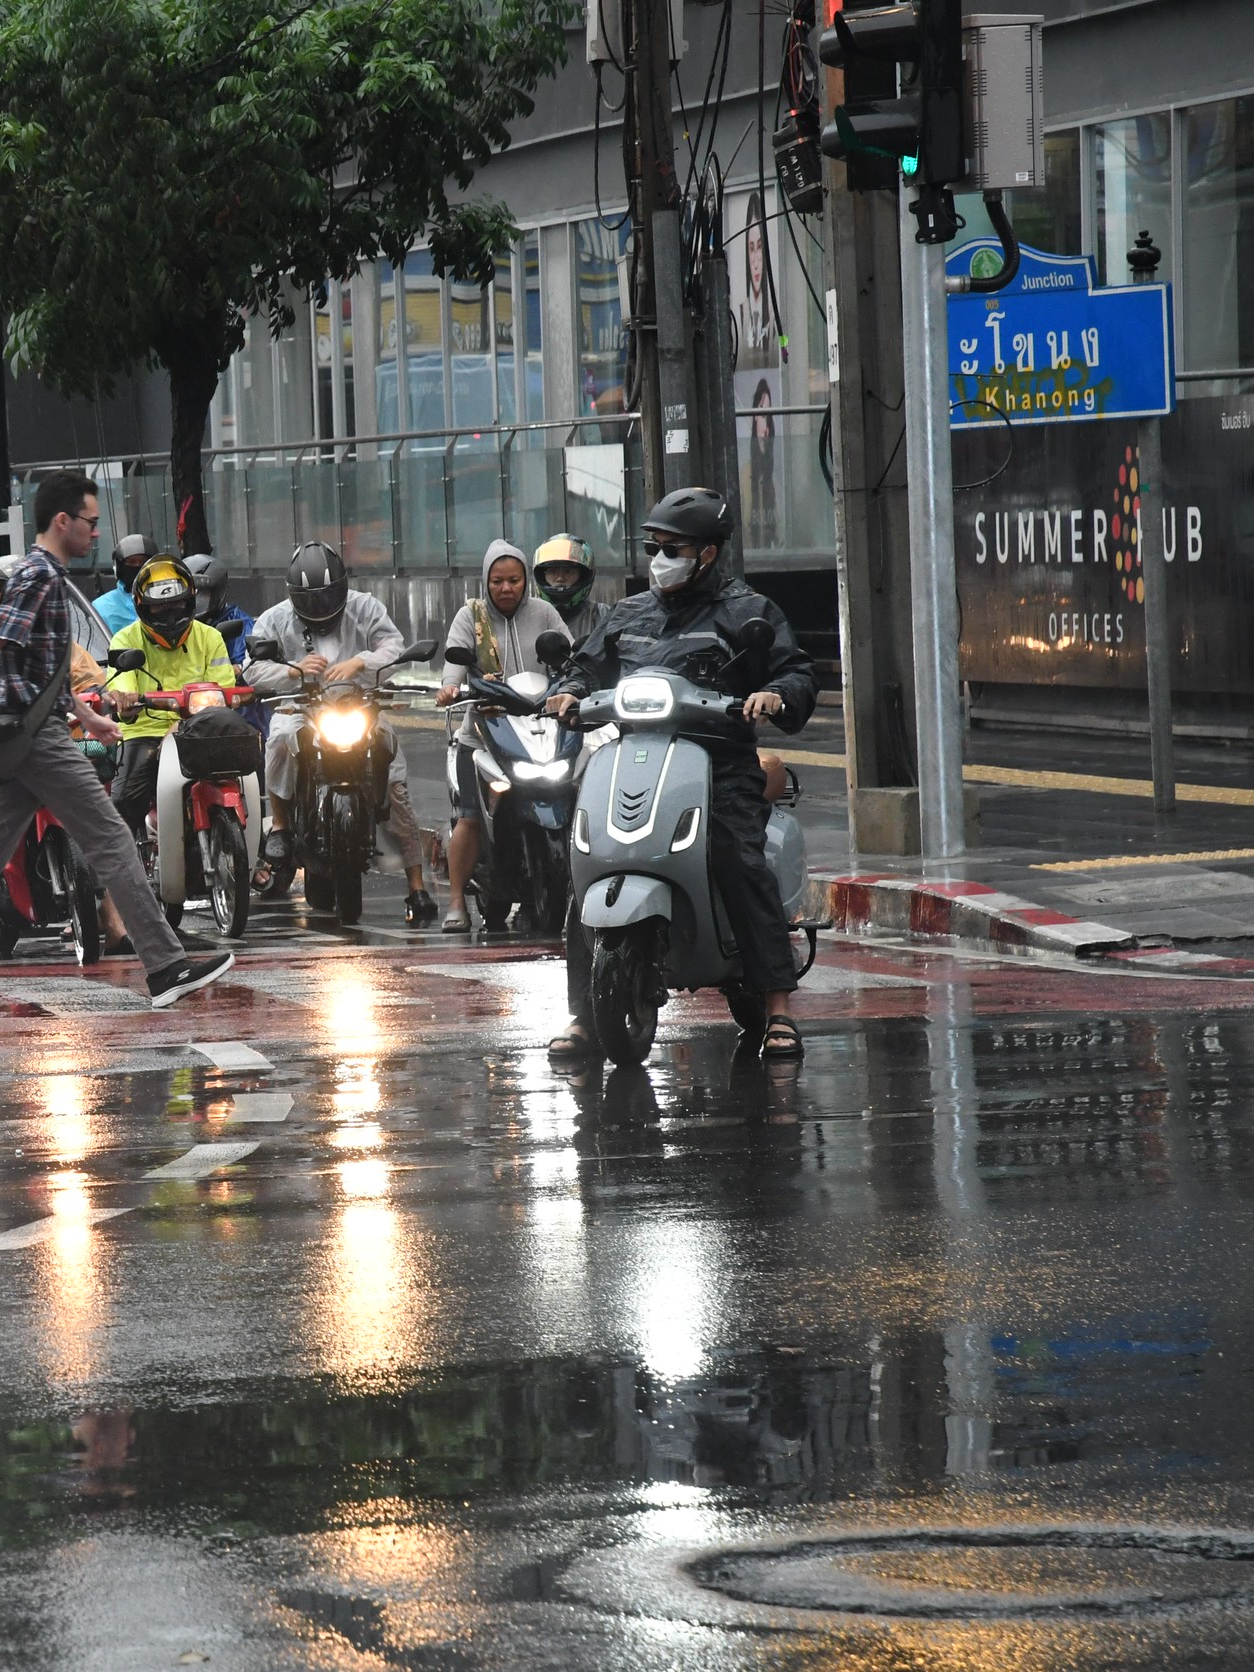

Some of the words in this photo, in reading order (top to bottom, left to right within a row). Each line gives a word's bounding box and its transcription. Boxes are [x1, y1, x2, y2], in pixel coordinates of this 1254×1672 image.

[1022, 271, 1074, 291] Junction
[985, 386, 1095, 412] Khanong
[975, 509, 1108, 564] SUMMER
[1048, 612, 1124, 643] OFFICES
